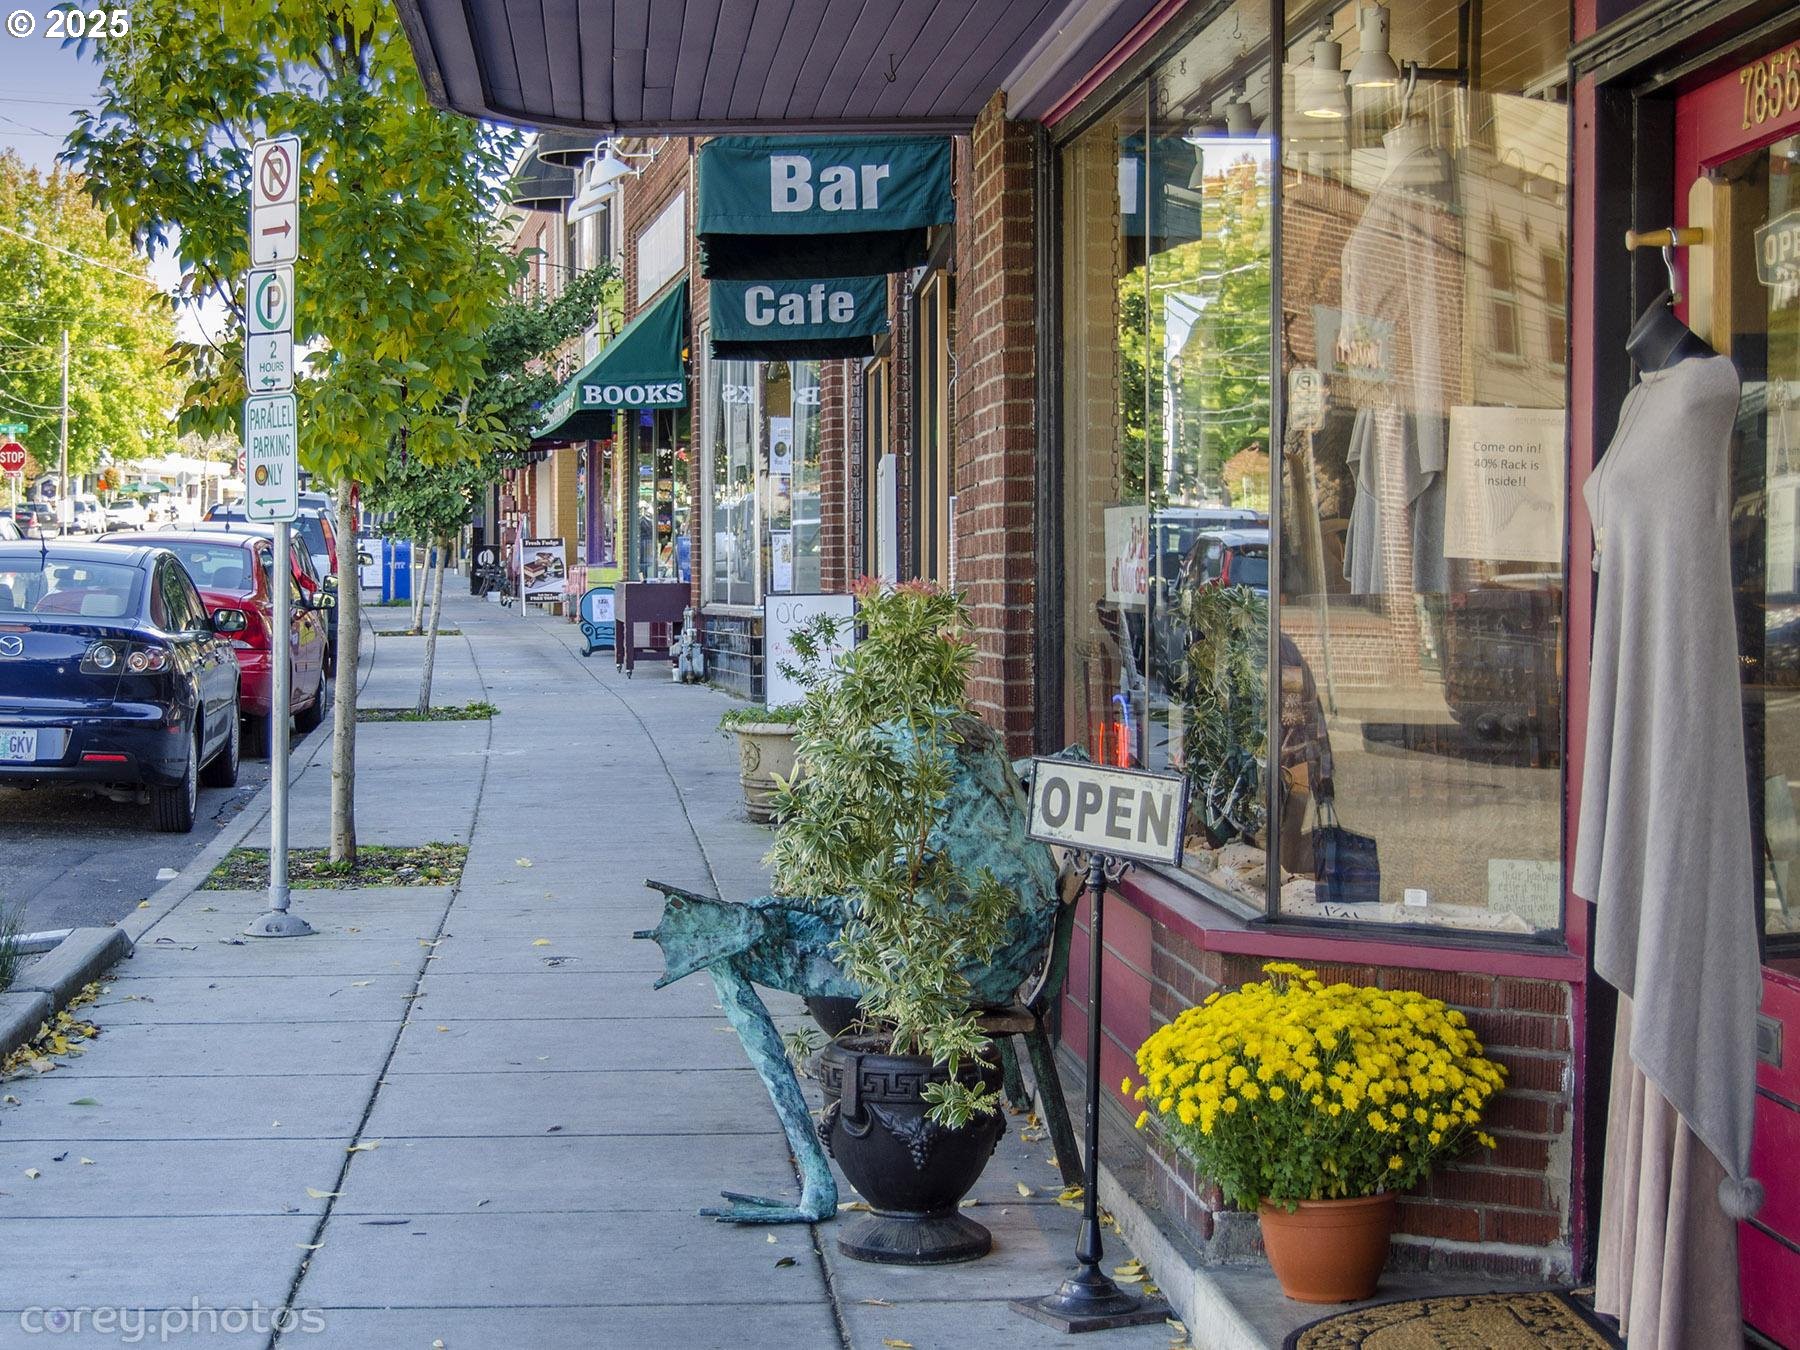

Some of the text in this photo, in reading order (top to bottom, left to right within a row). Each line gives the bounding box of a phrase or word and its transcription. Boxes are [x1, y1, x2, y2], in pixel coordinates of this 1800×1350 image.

[1740, 47, 1800, 130] 7856
[770, 155, 889, 213] Bar
[1765, 227, 1800, 266] OPE
[745, 284, 854, 326] Cafe
[270, 341, 277, 359] 2
[259, 361, 284, 374] HOURS
[583, 383, 684, 405] BOOKS
[249, 405, 293, 430] PARALLEL
[0, 451, 24, 463] STOP
[253, 434, 290, 458] PARKING
[1473, 441, 1542, 453] Come on in!
[255, 464, 283, 487] NLY
[1474, 458, 1540, 471] 40% Rack is
[1484, 476, 1527, 487] inside!!
[9, 736, 34, 754] GKV
[1041, 776, 1172, 847] OPEN
